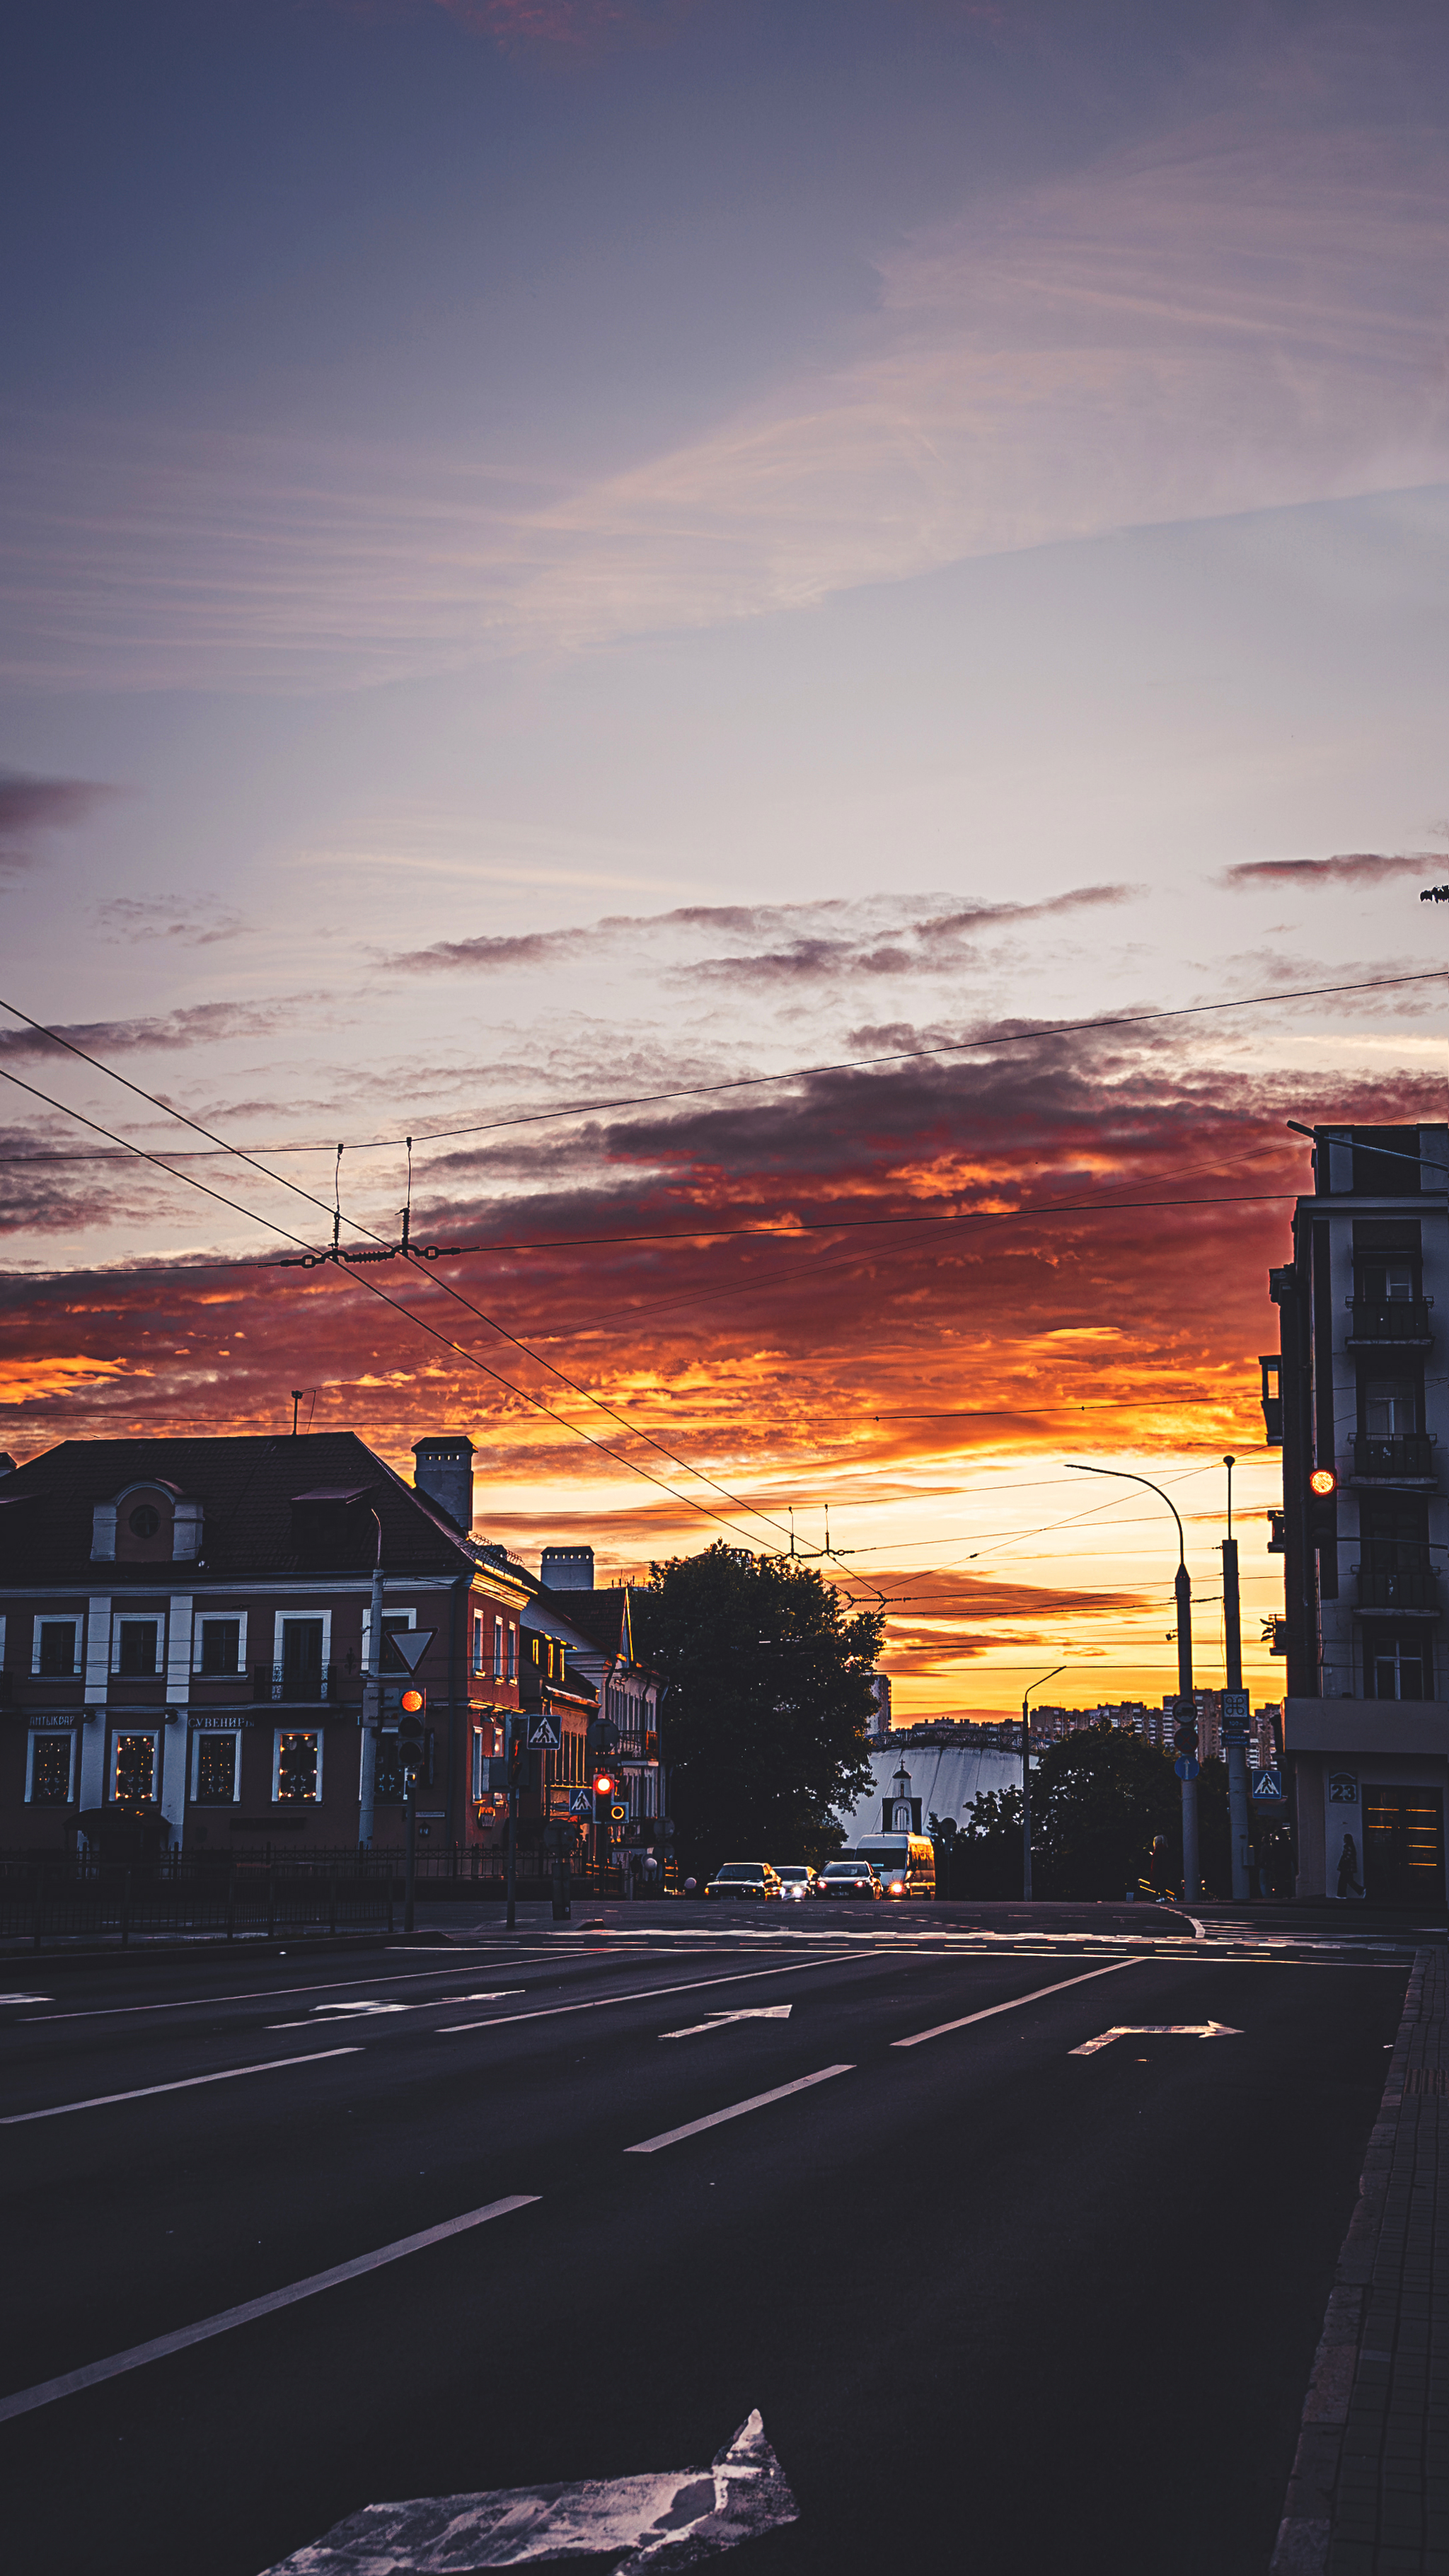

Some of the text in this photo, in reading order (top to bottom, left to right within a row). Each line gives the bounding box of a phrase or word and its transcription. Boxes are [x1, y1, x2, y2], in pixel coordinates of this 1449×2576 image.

[29, 1716, 75, 1726] АНТЫКВАР
[187, 1717, 255, 1728] СУВЕНИРЫ
[1332, 1784, 1356, 1800] 23
